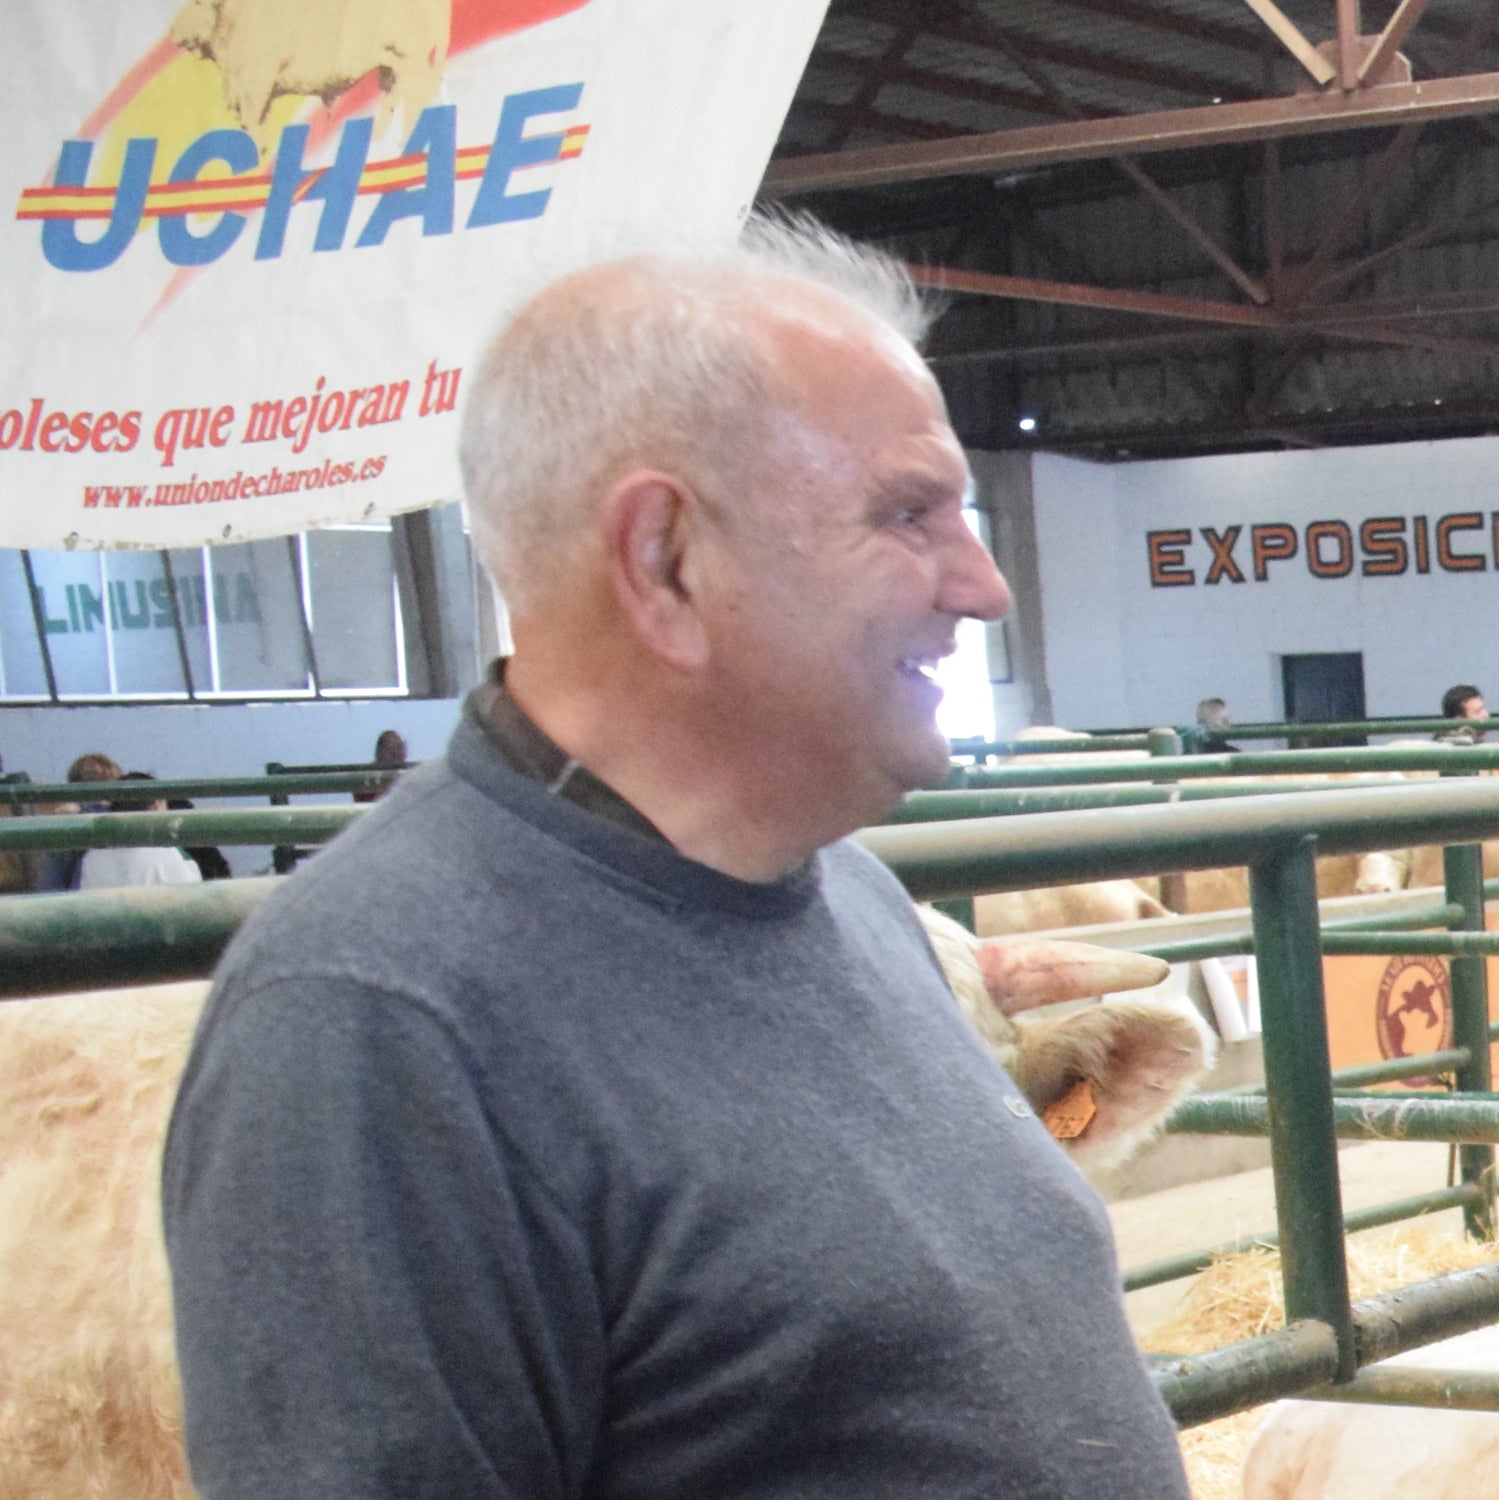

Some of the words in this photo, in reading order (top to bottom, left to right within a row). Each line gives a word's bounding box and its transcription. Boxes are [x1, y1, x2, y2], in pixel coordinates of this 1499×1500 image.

[41, 82, 585, 272] UCHAE
[154, 405, 235, 467] que
[241, 376, 410, 454] mejoran
[418, 359, 463, 417] tu
[82, 454, 388, 508] www.uniondecharoles.es
